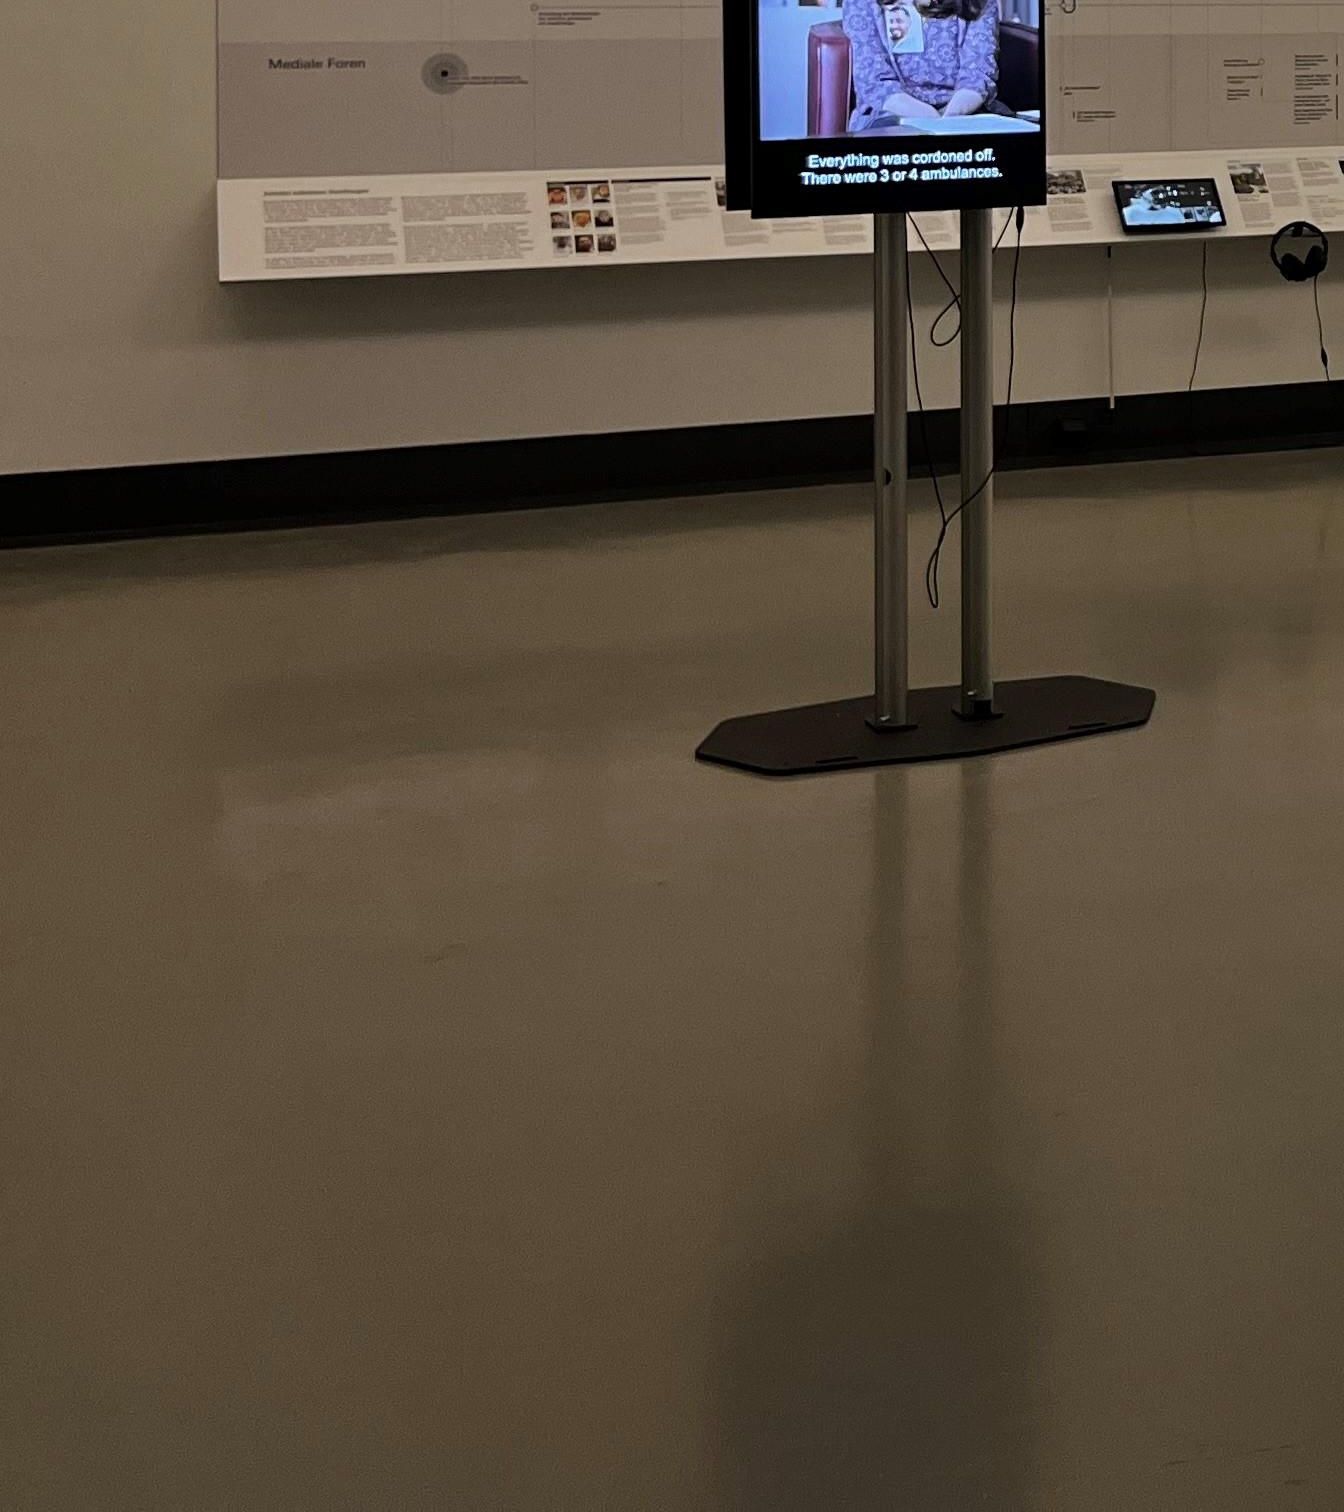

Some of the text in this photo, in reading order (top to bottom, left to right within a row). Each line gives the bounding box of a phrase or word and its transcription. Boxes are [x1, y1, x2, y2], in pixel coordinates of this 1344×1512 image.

[268, 57, 366, 70] Mediale Foren
[808, 148, 996, 170] Everything was cordoned off.
[801, 166, 1003, 185] There were 3 or 4 ambulances.
